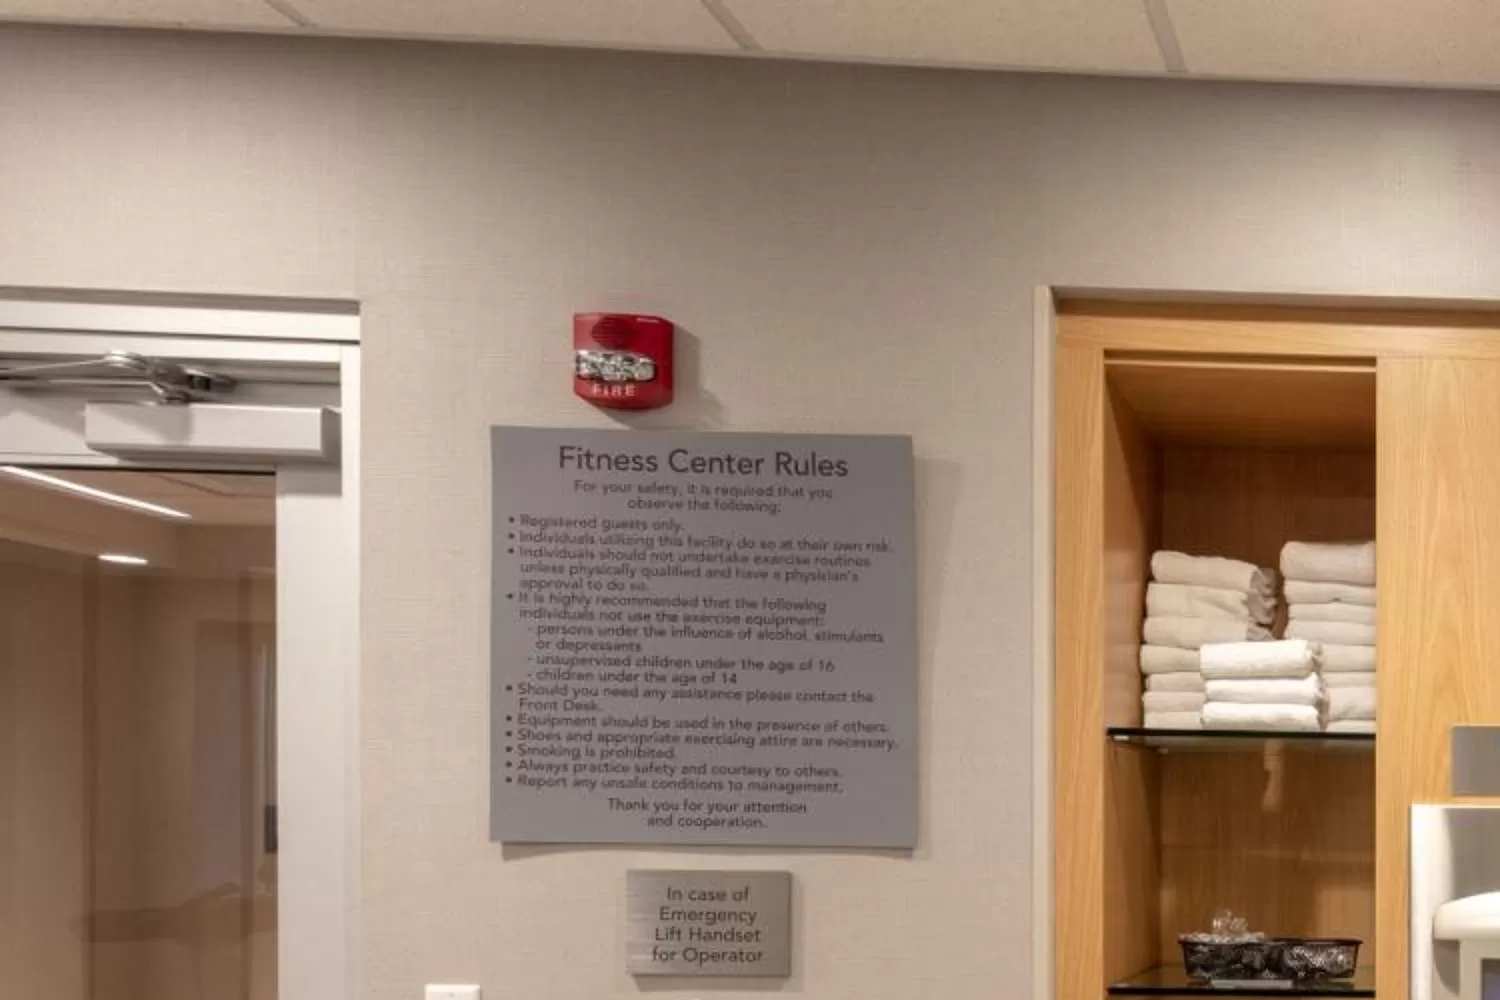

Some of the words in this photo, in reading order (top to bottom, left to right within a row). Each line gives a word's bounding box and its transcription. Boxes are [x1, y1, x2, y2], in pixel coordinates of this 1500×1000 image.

[592, 383, 636, 398] FIRE
[559, 445, 658, 473] Fitness
[668, 448, 765, 475] Center
[775, 451, 849, 478] Rules
[573, 480, 596, 493] For
[602, 482, 632, 496] your
[687, 483, 698, 496] it
[701, 484, 710, 497] is
[714, 484, 773, 500] required
[777, 485, 804, 498] that
[808, 487, 833, 501] you
[627, 496, 683, 510] observe
[687, 498, 710, 511] the
[519, 514, 597, 531] Registered
[602, 519, 648, 532] guests
[519, 532, 595, 545] Individuals
[600, 534, 653, 550] utilizing
[659, 534, 684, 548] this
[687, 536, 733, 551] facility
[737, 537, 756, 549] do
[760, 539, 777, 550] so
[780, 538, 794, 550] at
[797, 538, 829, 551] their
[519, 546, 595, 560] Individuals
[600, 548, 647, 562] should
[650, 551, 674, 563] not
[678, 552, 750, 565] undertake
[754, 554, 811, 566] exercise
[814, 555, 872, 568] routines
[520, 561, 565, 573] unless
[569, 562, 637, 579] physically
[641, 564, 702, 579] qualified
[706, 566, 732, 579] and
[735, 567, 768, 580] have
[773, 570, 781, 580] a
[520, 578, 584, 593] approval
[587, 578, 603, 591] to
[607, 578, 625, 591] do
[519, 592, 528, 604] It
[534, 592, 545, 604] is
[549, 593, 592, 609] highly
[596, 593, 699, 608] recommended
[703, 596, 731, 609] that
[735, 597, 759, 610] the
[762, 597, 827, 614] following
[519, 607, 595, 620] individuals
[600, 610, 623, 621] not
[628, 612, 651, 623] use
[655, 611, 680, 623] the
[683, 614, 741, 626] exercise
[536, 626, 595, 639] persons
[598, 624, 639, 637] under
[643, 626, 667, 638] the
[671, 625, 733, 640] influence
[737, 629, 752, 641] of
[814, 629, 884, 644] stimulants
[535, 640, 551, 650] or
[556, 638, 642, 654] depressants
[535, 655, 632, 670] unsupervised
[635, 655, 691, 668] children
[695, 657, 736, 670] under
[741, 658, 764, 671] the
[768, 660, 794, 674] age
[799, 657, 813, 671] of
[819, 658, 835, 672] 16
[535, 668, 595, 682] children
[599, 669, 640, 683] under
[643, 671, 667, 684] the
[671, 673, 697, 687] age
[701, 672, 715, 684] of
[721, 672, 737, 684] 14
[517, 682, 568, 697] Should
[573, 686, 599, 699] you
[603, 685, 639, 699] need
[643, 688, 666, 701] any
[671, 688, 741, 702] assistance
[745, 688, 792, 704] please
[795, 689, 847, 703] contact
[850, 689, 874, 703] the
[519, 697, 558, 711] Front
[517, 713, 597, 728] Equipment
[601, 714, 649, 729] should
[652, 715, 671, 729] be
[675, 716, 708, 730] used
[712, 716, 725, 729] in
[729, 716, 753, 731] the
[757, 719, 821, 733] presence
[824, 719, 838, 732] of
[517, 728, 562, 742] Shoes
[566, 729, 593, 743] and
[597, 731, 681, 747] appropriate
[684, 733, 756, 749] exercising
[759, 734, 798, 748] attire
[801, 737, 823, 748] are
[517, 743, 581, 760] Smoking
[585, 745, 596, 758] is
[517, 760, 568, 775] Always
[573, 761, 630, 776] practice
[634, 762, 675, 777] safety
[680, 763, 707, 776] and
[711, 765, 771, 779] courtesy
[774, 765, 790, 778] to
[517, 774, 567, 789] Report
[572, 777, 597, 793] any
[601, 776, 647, 790] unsafe
[651, 778, 724, 792] conditions
[728, 780, 743, 792] to
[608, 797, 649, 812] Thank
[652, 799, 679, 814] you
[683, 797, 705, 813] for
[708, 801, 739, 815] your
[743, 801, 808, 815] attention
[647, 814, 673, 828] and
[666, 886, 682, 901] In
[688, 890, 727, 902] case
[732, 886, 749, 902] of
[659, 905, 757, 926] Emergency
[655, 926, 681, 942] Lift
[689, 927, 762, 944] Handset
[652, 946, 677, 962] for
[682, 946, 763, 968] Operator
